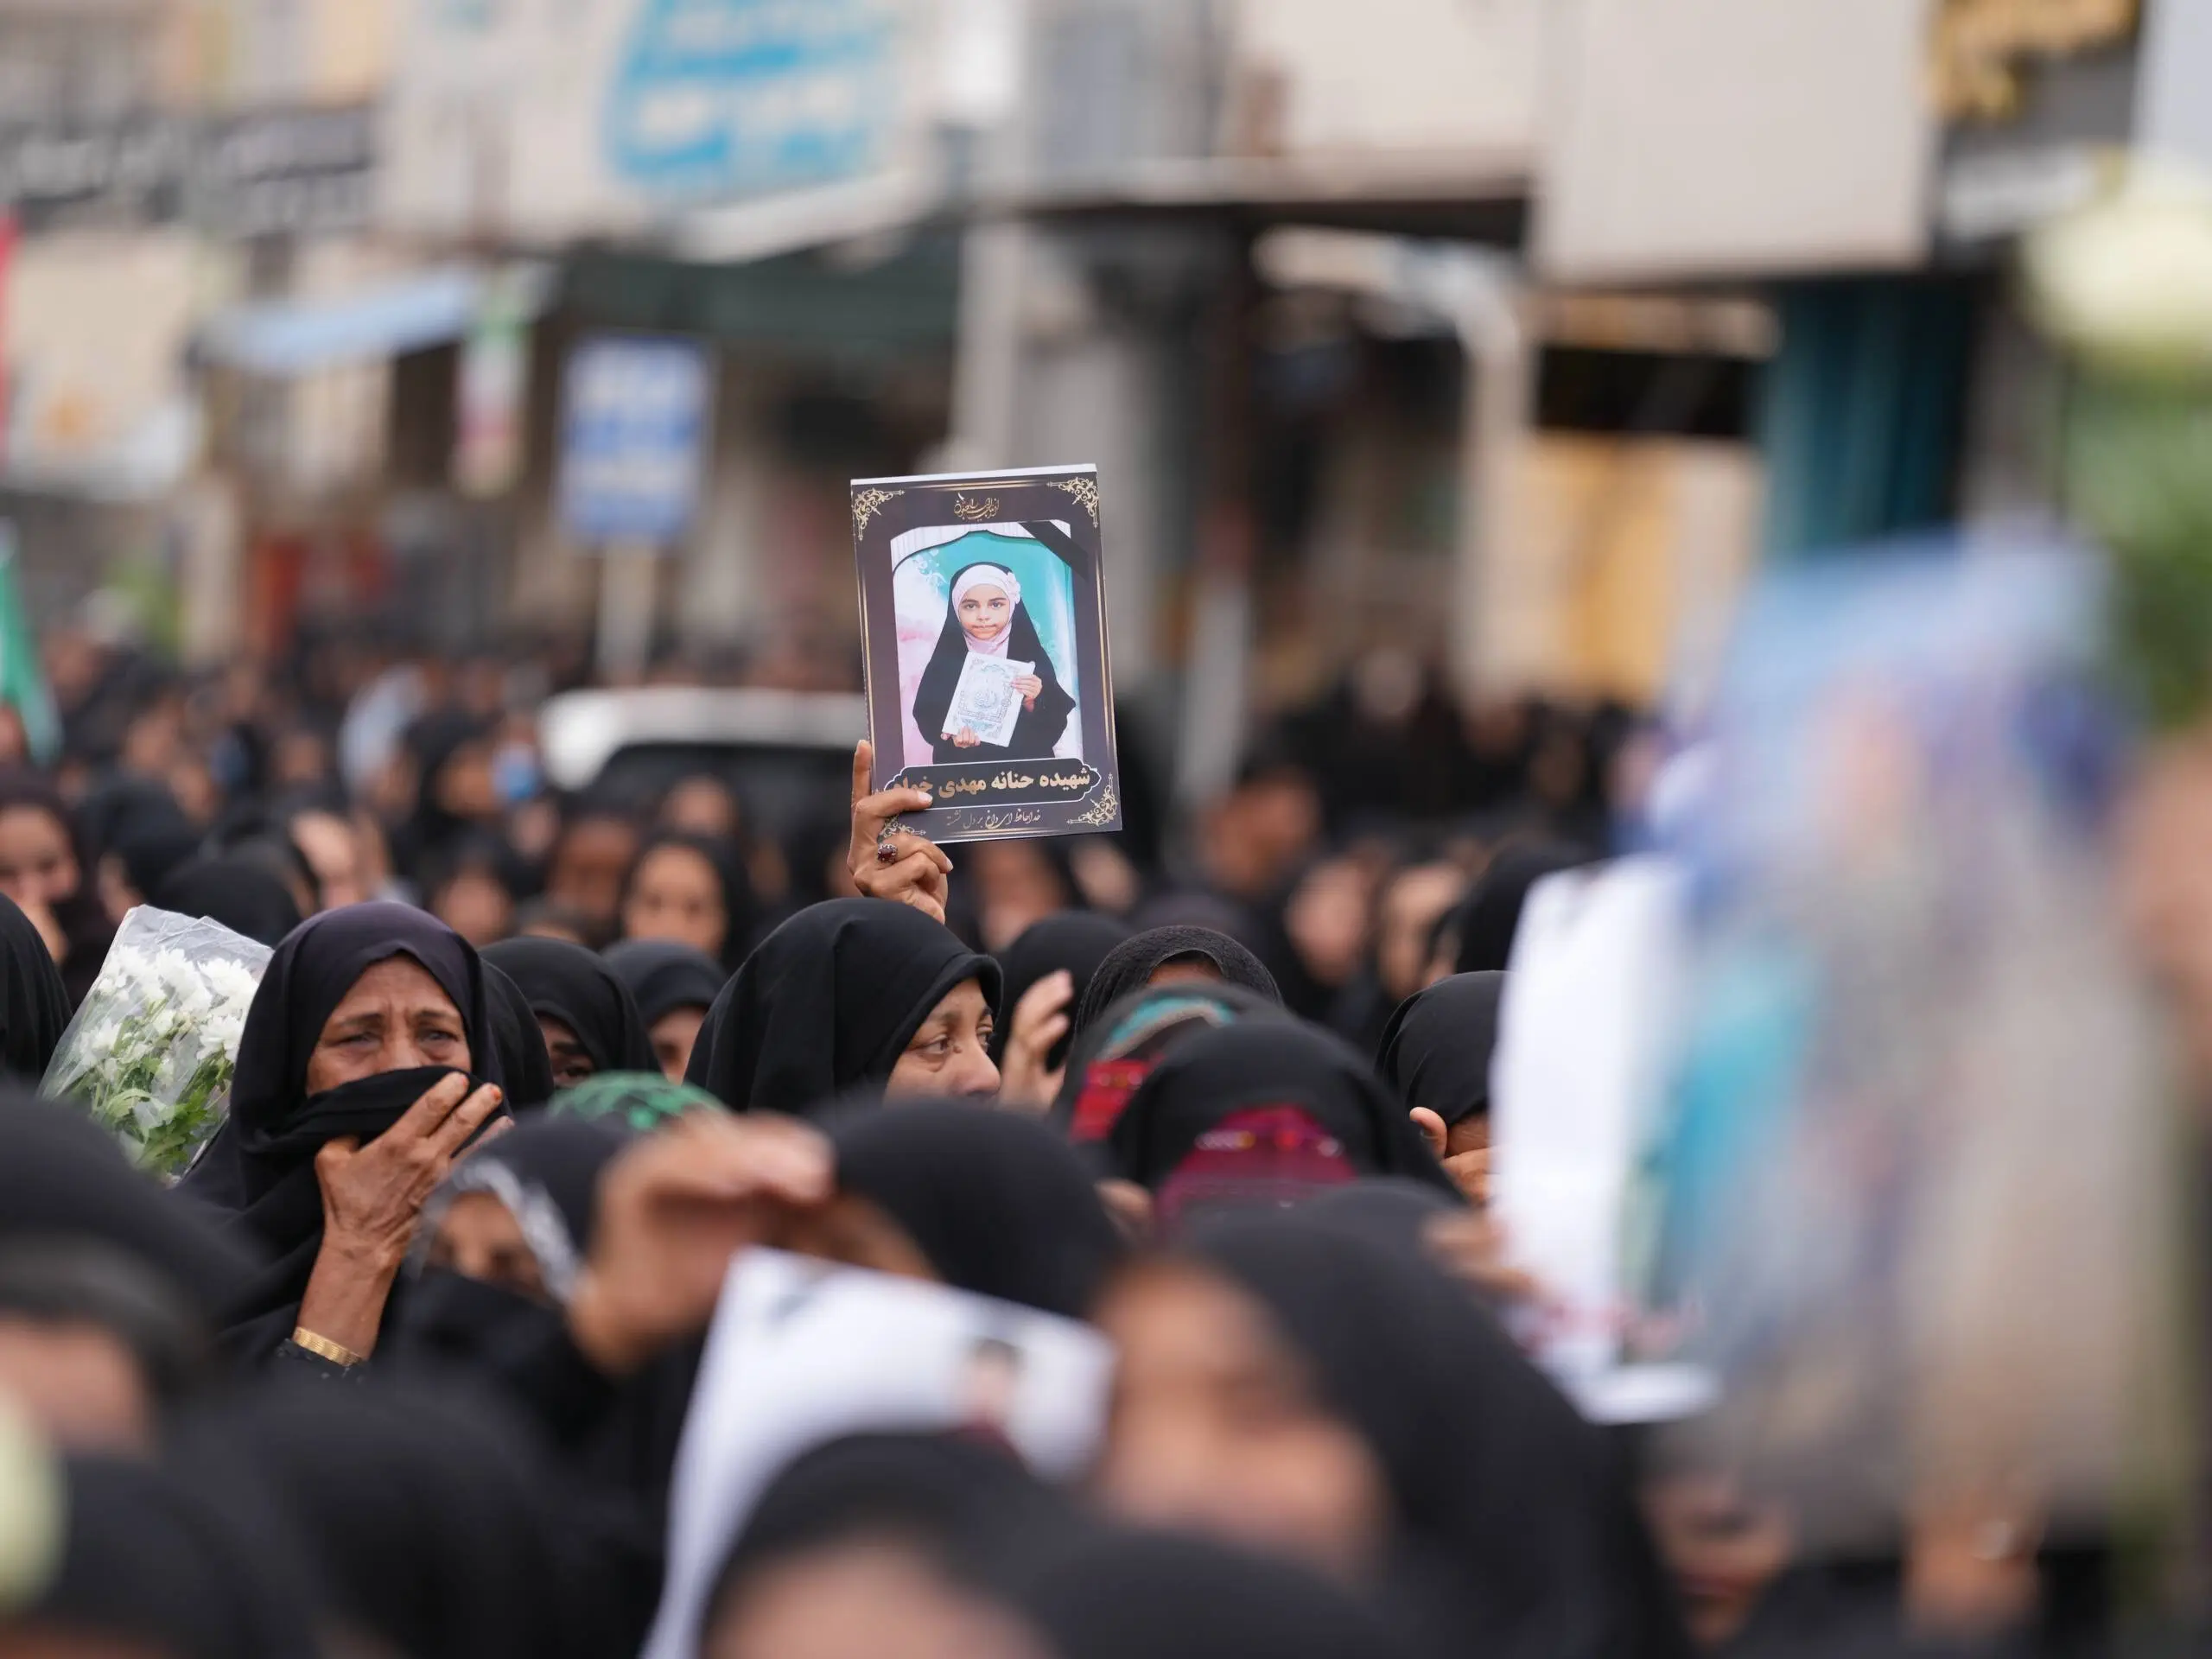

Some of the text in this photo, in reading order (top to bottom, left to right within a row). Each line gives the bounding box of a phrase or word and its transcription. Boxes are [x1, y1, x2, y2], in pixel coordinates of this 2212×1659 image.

[938, 777, 987, 799] مهدی
[991, 770, 1035, 790] حنانه
[1039, 767, 1090, 791] شهیده
